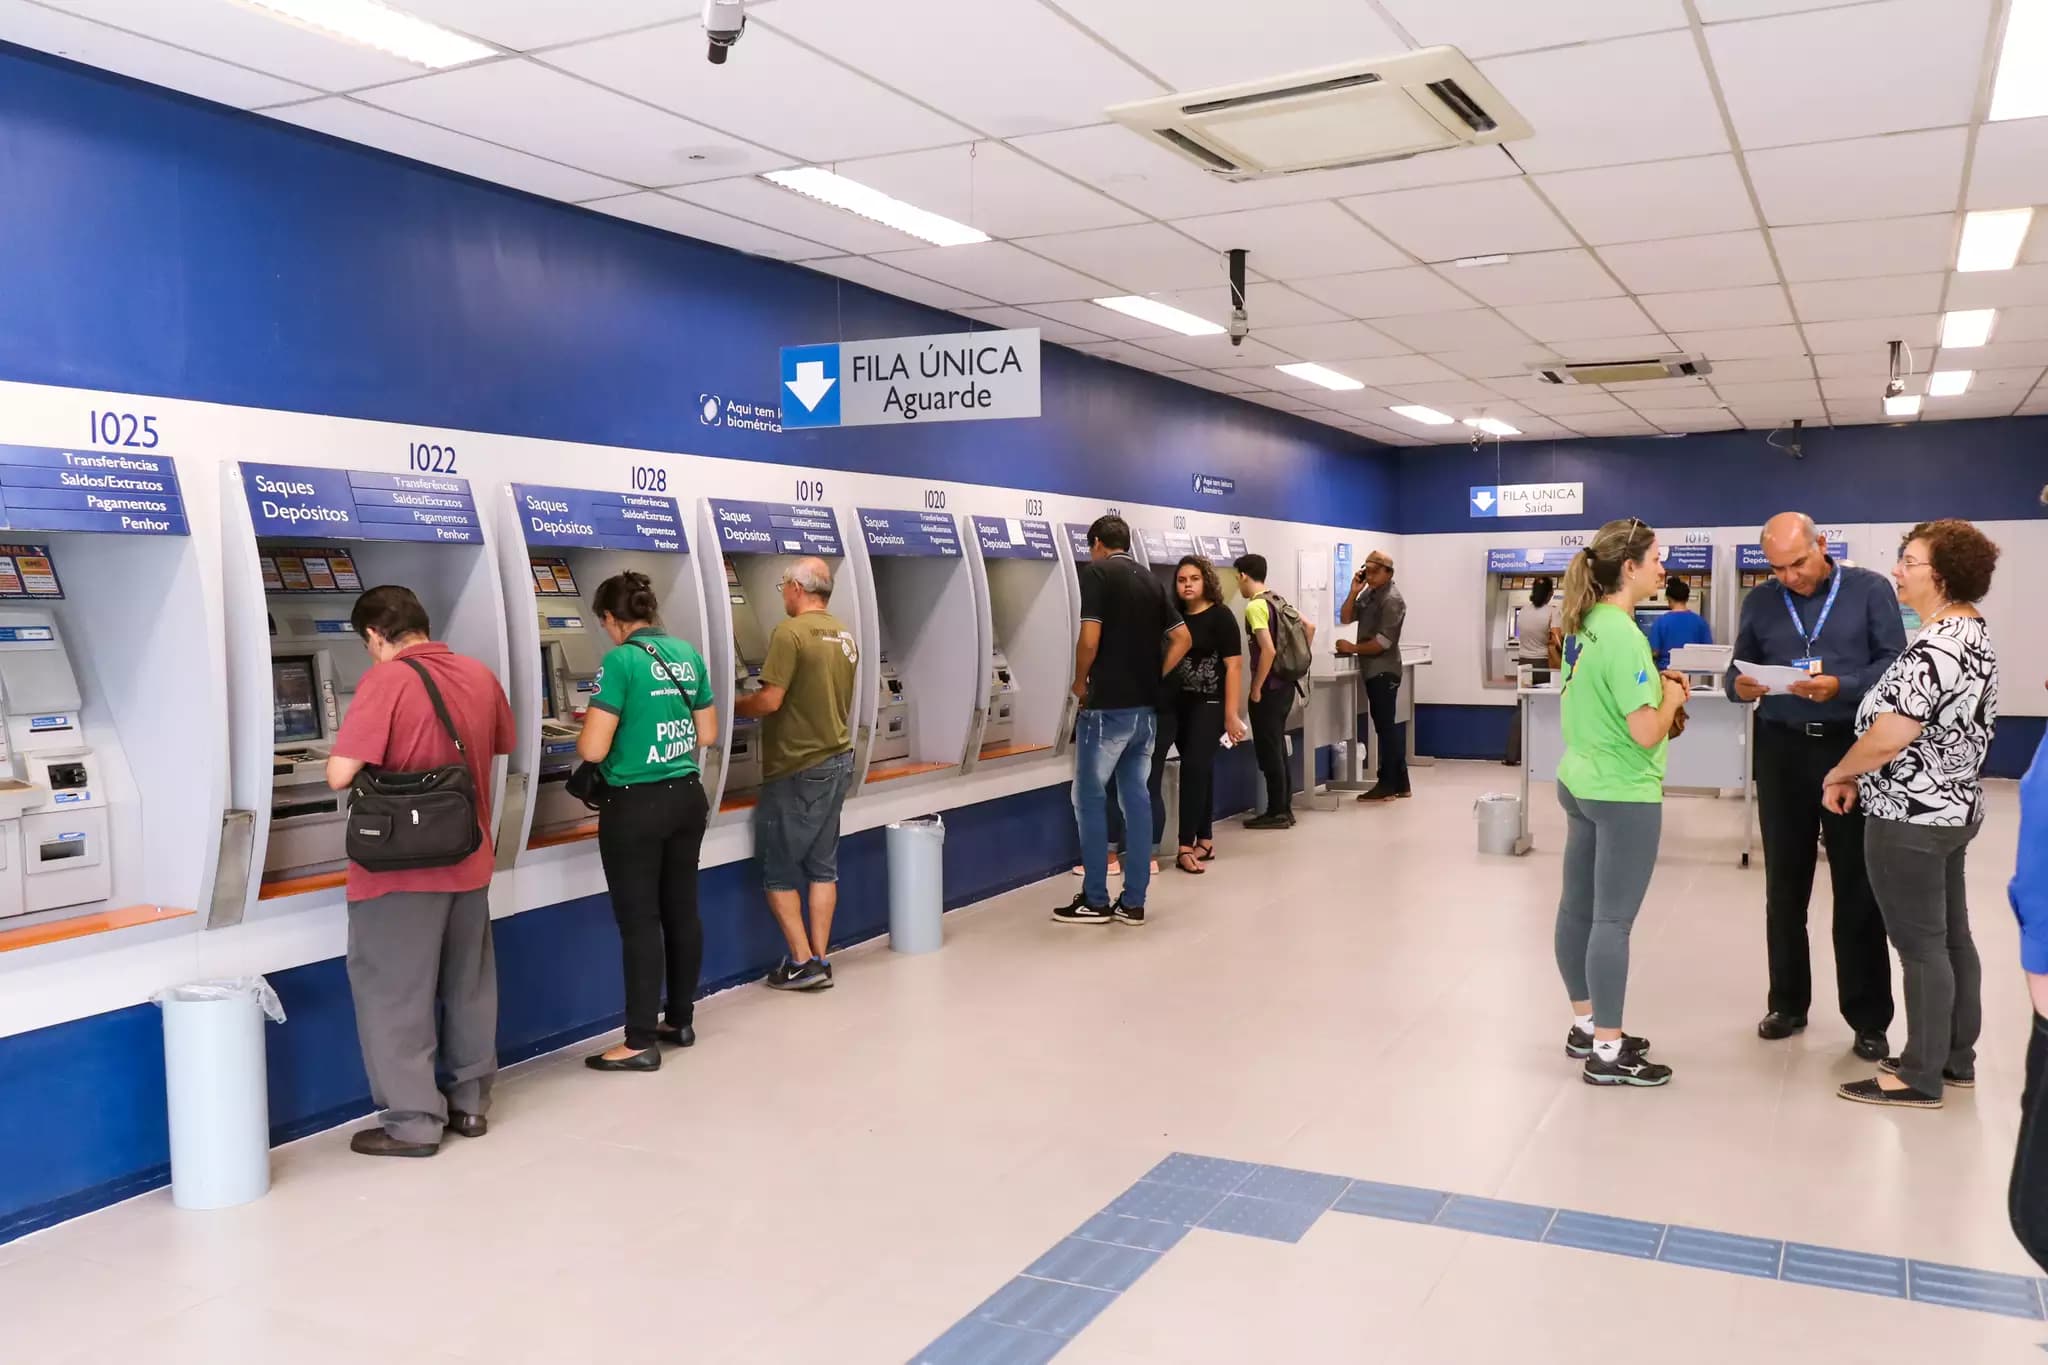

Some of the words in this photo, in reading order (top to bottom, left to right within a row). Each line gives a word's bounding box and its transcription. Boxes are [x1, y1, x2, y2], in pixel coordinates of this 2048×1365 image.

[852, 352, 910, 383] FILA
[918, 343, 1023, 378] ÚNICA
[726, 400, 752, 417] Aqui
[754, 406, 775, 418] tem
[882, 381, 993, 420] Aguarde
[91, 410, 159, 448] 1025
[727, 414, 782, 433] biométrica
[62, 452, 159, 472] Transferências
[410, 442, 458, 475] 1022
[60, 472, 164, 492] Saldos/Extratos
[255, 475, 315, 498] Saques
[392, 476, 460, 492] Transferências
[631, 466, 667, 492] 1028
[796, 479, 824, 502] 1019
[924, 489, 946, 509] 1020
[1503, 490, 1528, 501] FILA
[86, 494, 167, 513] Pagamentos
[392, 493, 463, 508] Saldos/Extratos
[526, 495, 569, 515] Saques
[1025, 498, 1043, 516] 1033
[1524, 502, 1553, 513] Saída
[261, 501, 350, 524] Depósitos
[413, 510, 469, 524] Pagamentos
[719, 508, 752, 525] Saques
[120, 516, 170, 531] Penhor
[531, 517, 594, 537] Depósitos
[863, 515, 889, 531] Saques
[436, 528, 471, 540] Penhor
[723, 527, 772, 544] Depósitos
[868, 532, 905, 547] Depósitos
[1560, 535, 1584, 546] 1042
[654, 539, 680, 550] Penhor
[656, 719, 695, 742] POSSO
